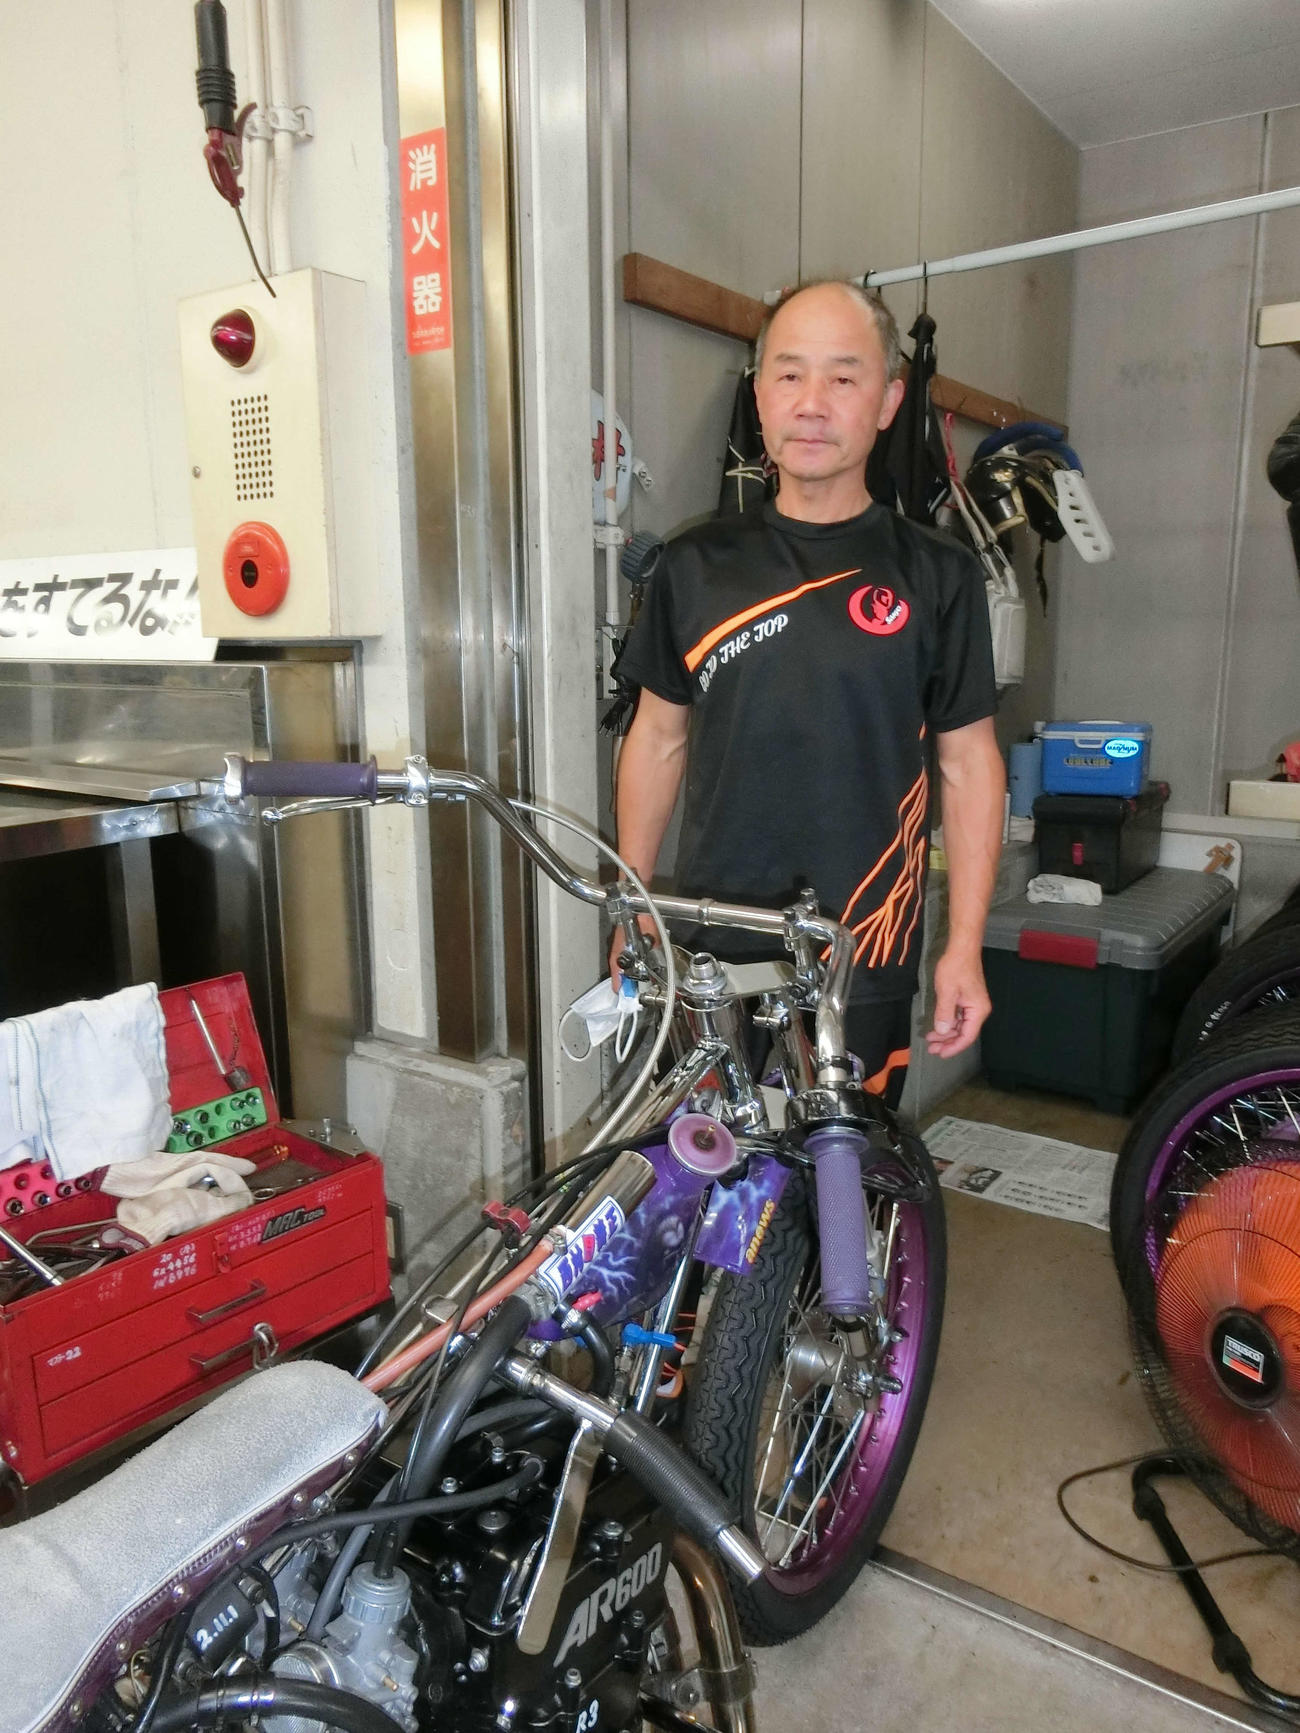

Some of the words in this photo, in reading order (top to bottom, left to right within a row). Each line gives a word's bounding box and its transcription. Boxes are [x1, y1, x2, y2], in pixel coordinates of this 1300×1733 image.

[408, 143, 441, 315] 消火器
[719, 631, 751, 664] THE
[753, 613, 789, 643] TOP
[262, 1207, 305, 1240] MAC
[553, 1542, 663, 1668] AR600
